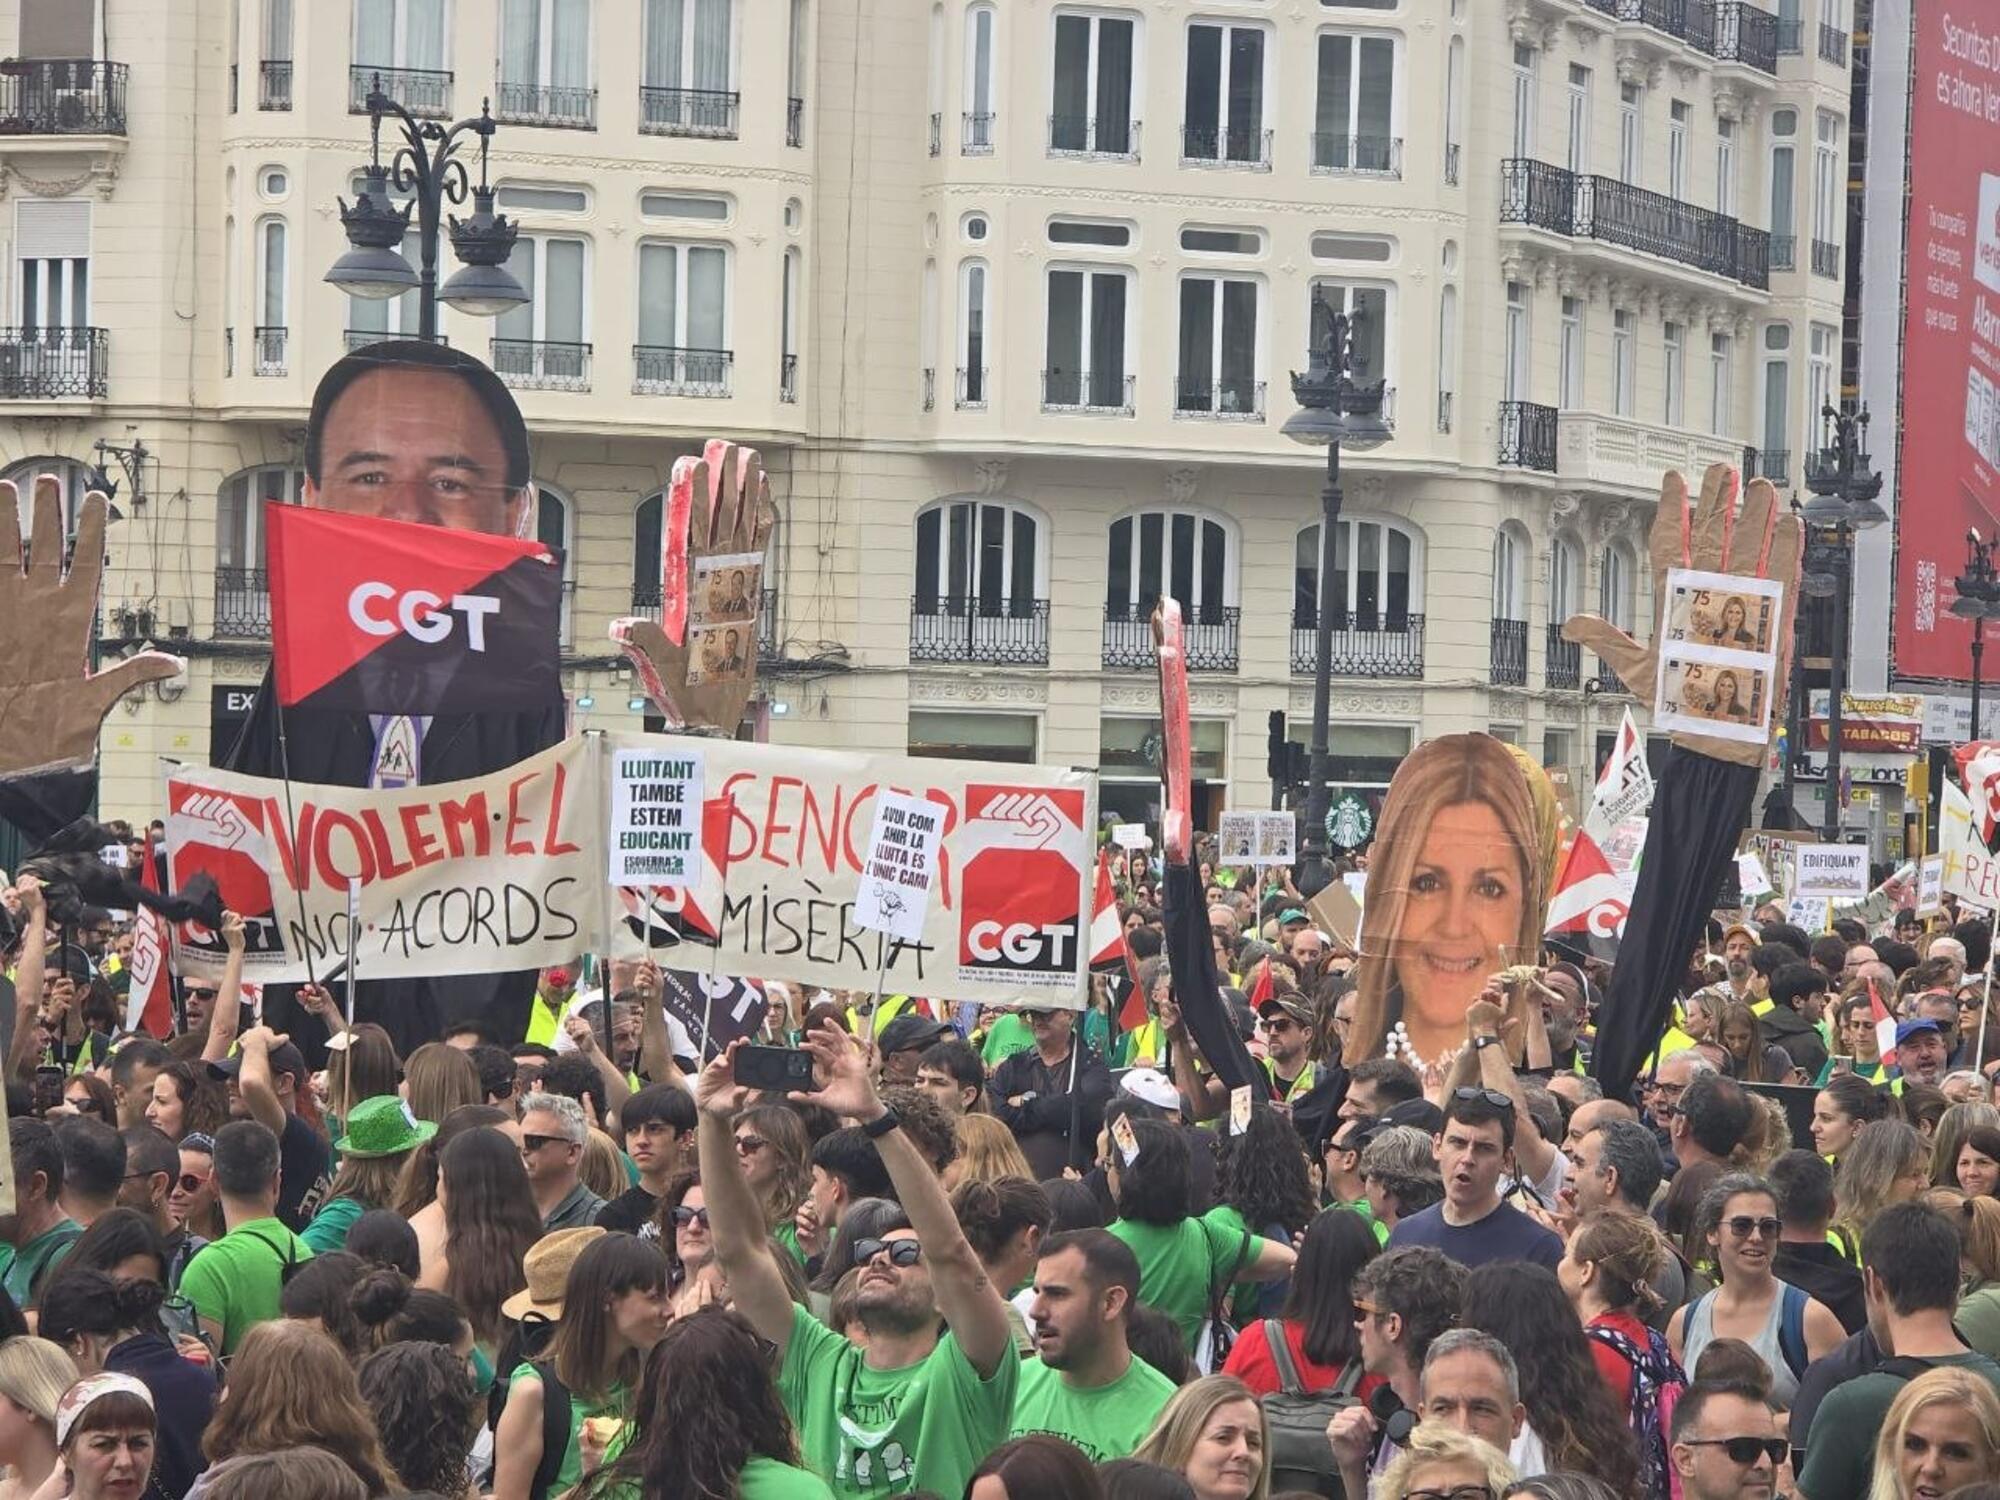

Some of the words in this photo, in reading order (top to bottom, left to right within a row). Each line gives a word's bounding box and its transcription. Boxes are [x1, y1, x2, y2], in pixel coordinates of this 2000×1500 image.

[1937, 71, 1950, 104] es
[1951, 69, 1981, 117] ahora
[1691, 589, 1711, 606] 75
[348, 581, 500, 653] CGT
[1672, 629, 1684, 640] 75
[1684, 662, 1703, 679] 75
[1664, 701, 1678, 713] 75
[1842, 728, 1912, 743] TABACOS
[621, 760, 696, 779] LLUITANT
[629, 781, 685, 803] TAMBÉ
[630, 808, 682, 827] ESTEM
[882, 805, 905, 826] AVUI
[907, 812, 935, 833] COM
[619, 831, 693, 851] EDUCANT
[722, 772, 958, 911] SENCR
[882, 825, 908, 846] AHIR
[910, 832, 924, 850] LA
[875, 842, 908, 866] LLUITA
[380, 875, 578, 959] ACORDS
[967, 920, 1075, 967] CGT
